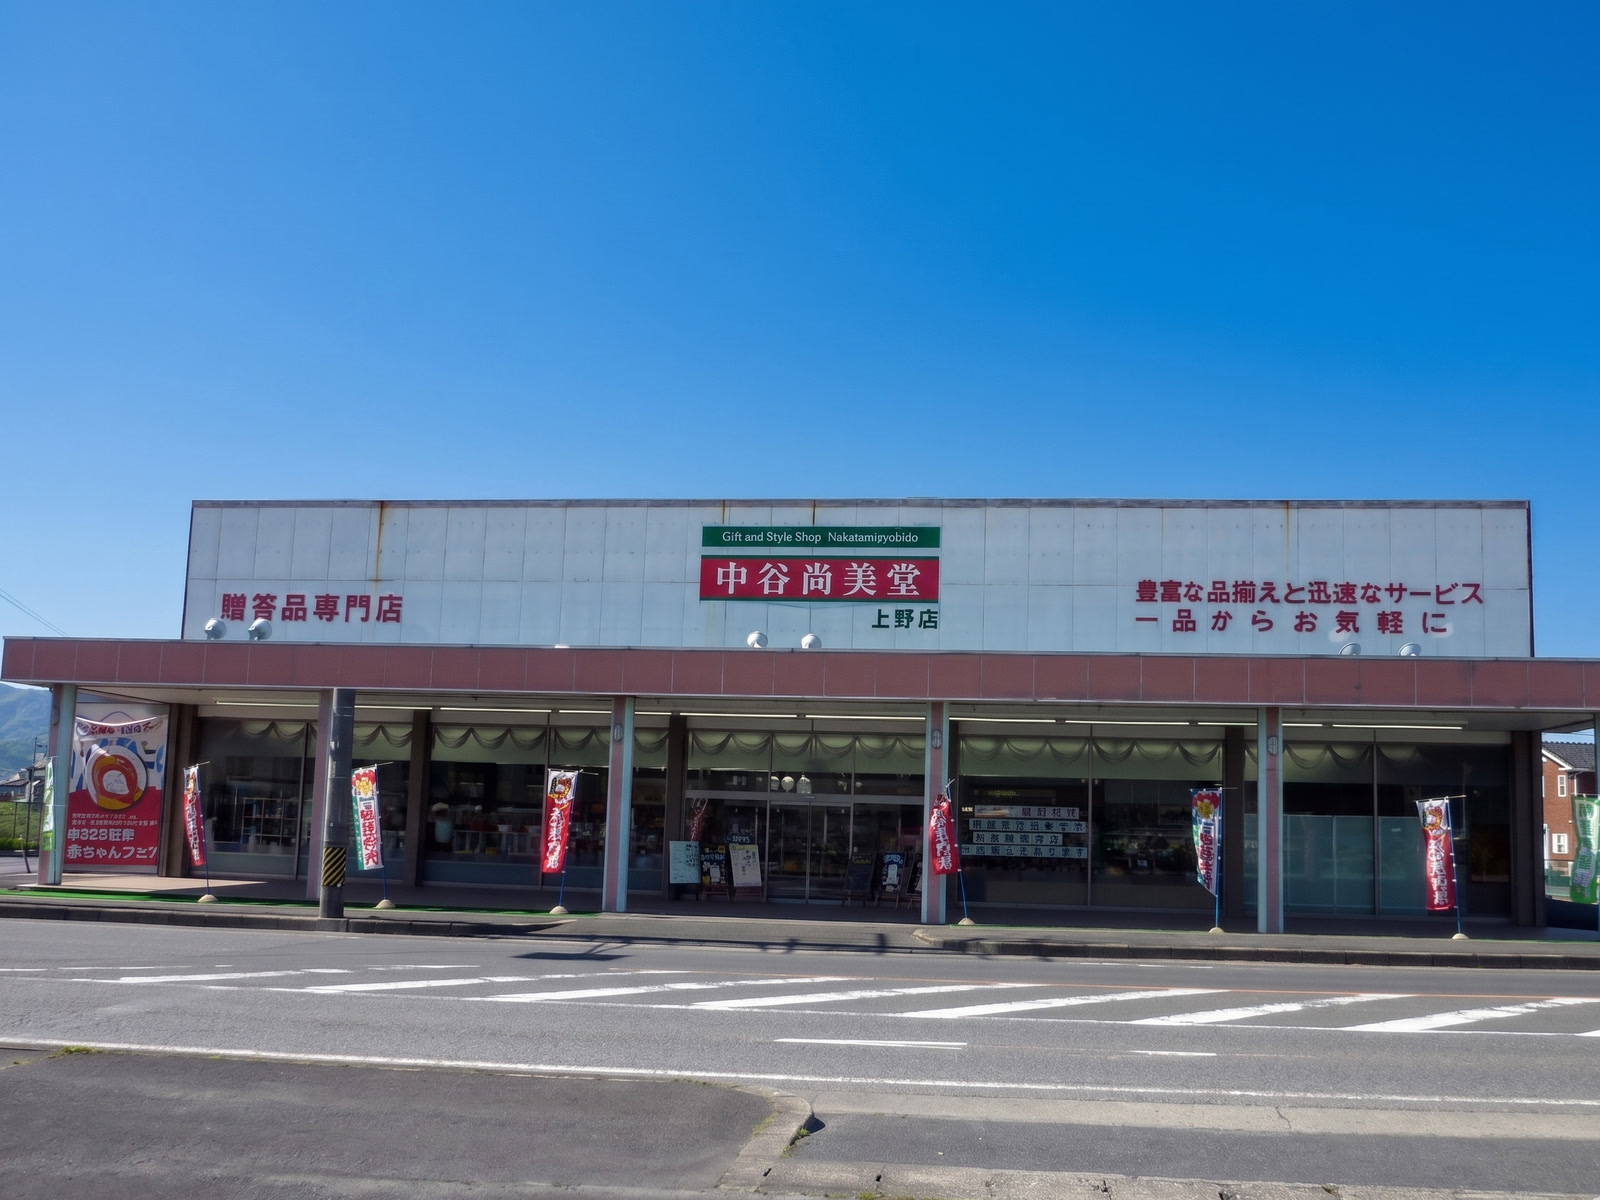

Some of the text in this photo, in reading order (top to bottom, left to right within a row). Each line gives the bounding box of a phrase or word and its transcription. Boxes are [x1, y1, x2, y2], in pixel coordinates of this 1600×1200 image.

[722, 531, 743, 542] Gift
[744, 531, 764, 542] and
[766, 531, 793, 544] Style
[794, 531, 822, 545] Shop
[716, 561, 921, 596] 中谷尚美堂
[1135, 580, 1484, 605] 豊富な品揃えと迅速なサービス
[220, 593, 403, 623] 贈答品専門店
[871, 608, 939, 630] 上野店
[1135, 609, 1447, 634] 一品からお気軽に
